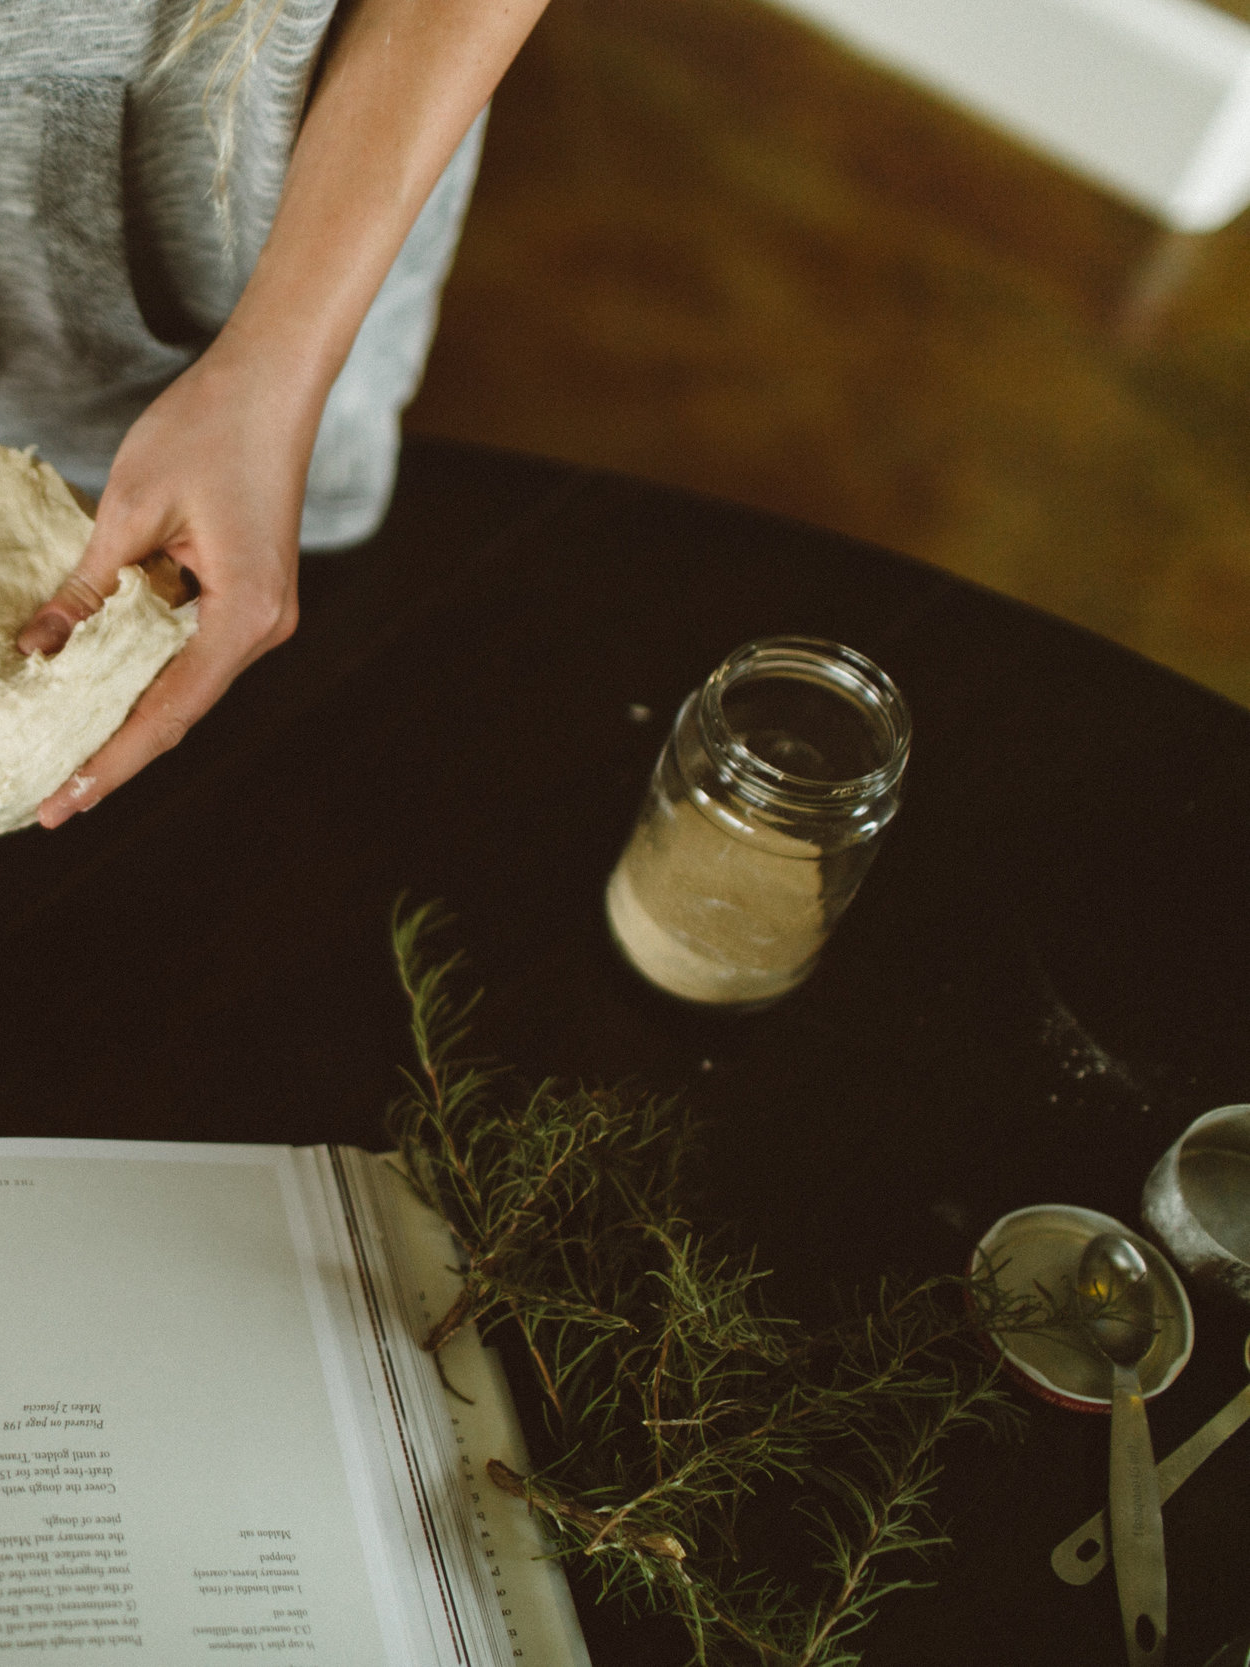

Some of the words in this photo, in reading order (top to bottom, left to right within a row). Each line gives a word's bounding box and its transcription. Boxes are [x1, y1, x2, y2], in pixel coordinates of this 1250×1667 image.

[23, 1401, 59, 1413] focaccia
[62, 1404, 68, 1413] 2
[71, 1404, 101, 1413] Makes
[3, 1421, 21, 1431] 198
[25, 1417, 48, 1428] page
[64, 1419, 104, 1430] Pictured
[31, 1448, 69, 1462] golden.
[72, 1451, 96, 1462] until
[99, 1451, 110, 1459] or
[0, 1470, 11, 1480] 15
[16, 1469, 30, 1479] for
[34, 1465, 60, 1478] place
[64, 1467, 113, 1477] draft-free
[2, 1486, 26, 1497] with
[29, 1482, 62, 1495] dough
[66, 1484, 81, 1495] the
[84, 1484, 116, 1494] Cover
[42, 1514, 78, 1528] dough.
[81, 1517, 92, 1528] of
[95, 1514, 121, 1526] piece
[58, 1532, 104, 1542] rosemary
[109, 1533, 124, 1543] the
[240, 1530, 254, 1539] salt
[257, 1530, 291, 1539] Maldon
[35, 1535, 54, 1546] and
[17, 1552, 49, 1563] Brush
[95, 1550, 111, 1560] the
[114, 1549, 127, 1557] on
[260, 1552, 296, 1563] chopped
[29, 1569, 50, 1578] into
[54, 1564, 104, 1578] fingertips
[108, 1563, 130, 1575] your
[193, 1568, 227, 1580] coarsely
[229, 1569, 258, 1579] leaves,
[261, 1567, 299, 1577] rosemary
[9, 1570, 26, 1580] the
[199, 1586, 221, 1596] fresh
[224, 1586, 233, 1594] of
[235, 1586, 269, 1595] handful
[272, 1585, 294, 1594] small
[297, 1585, 302, 1594] 1
